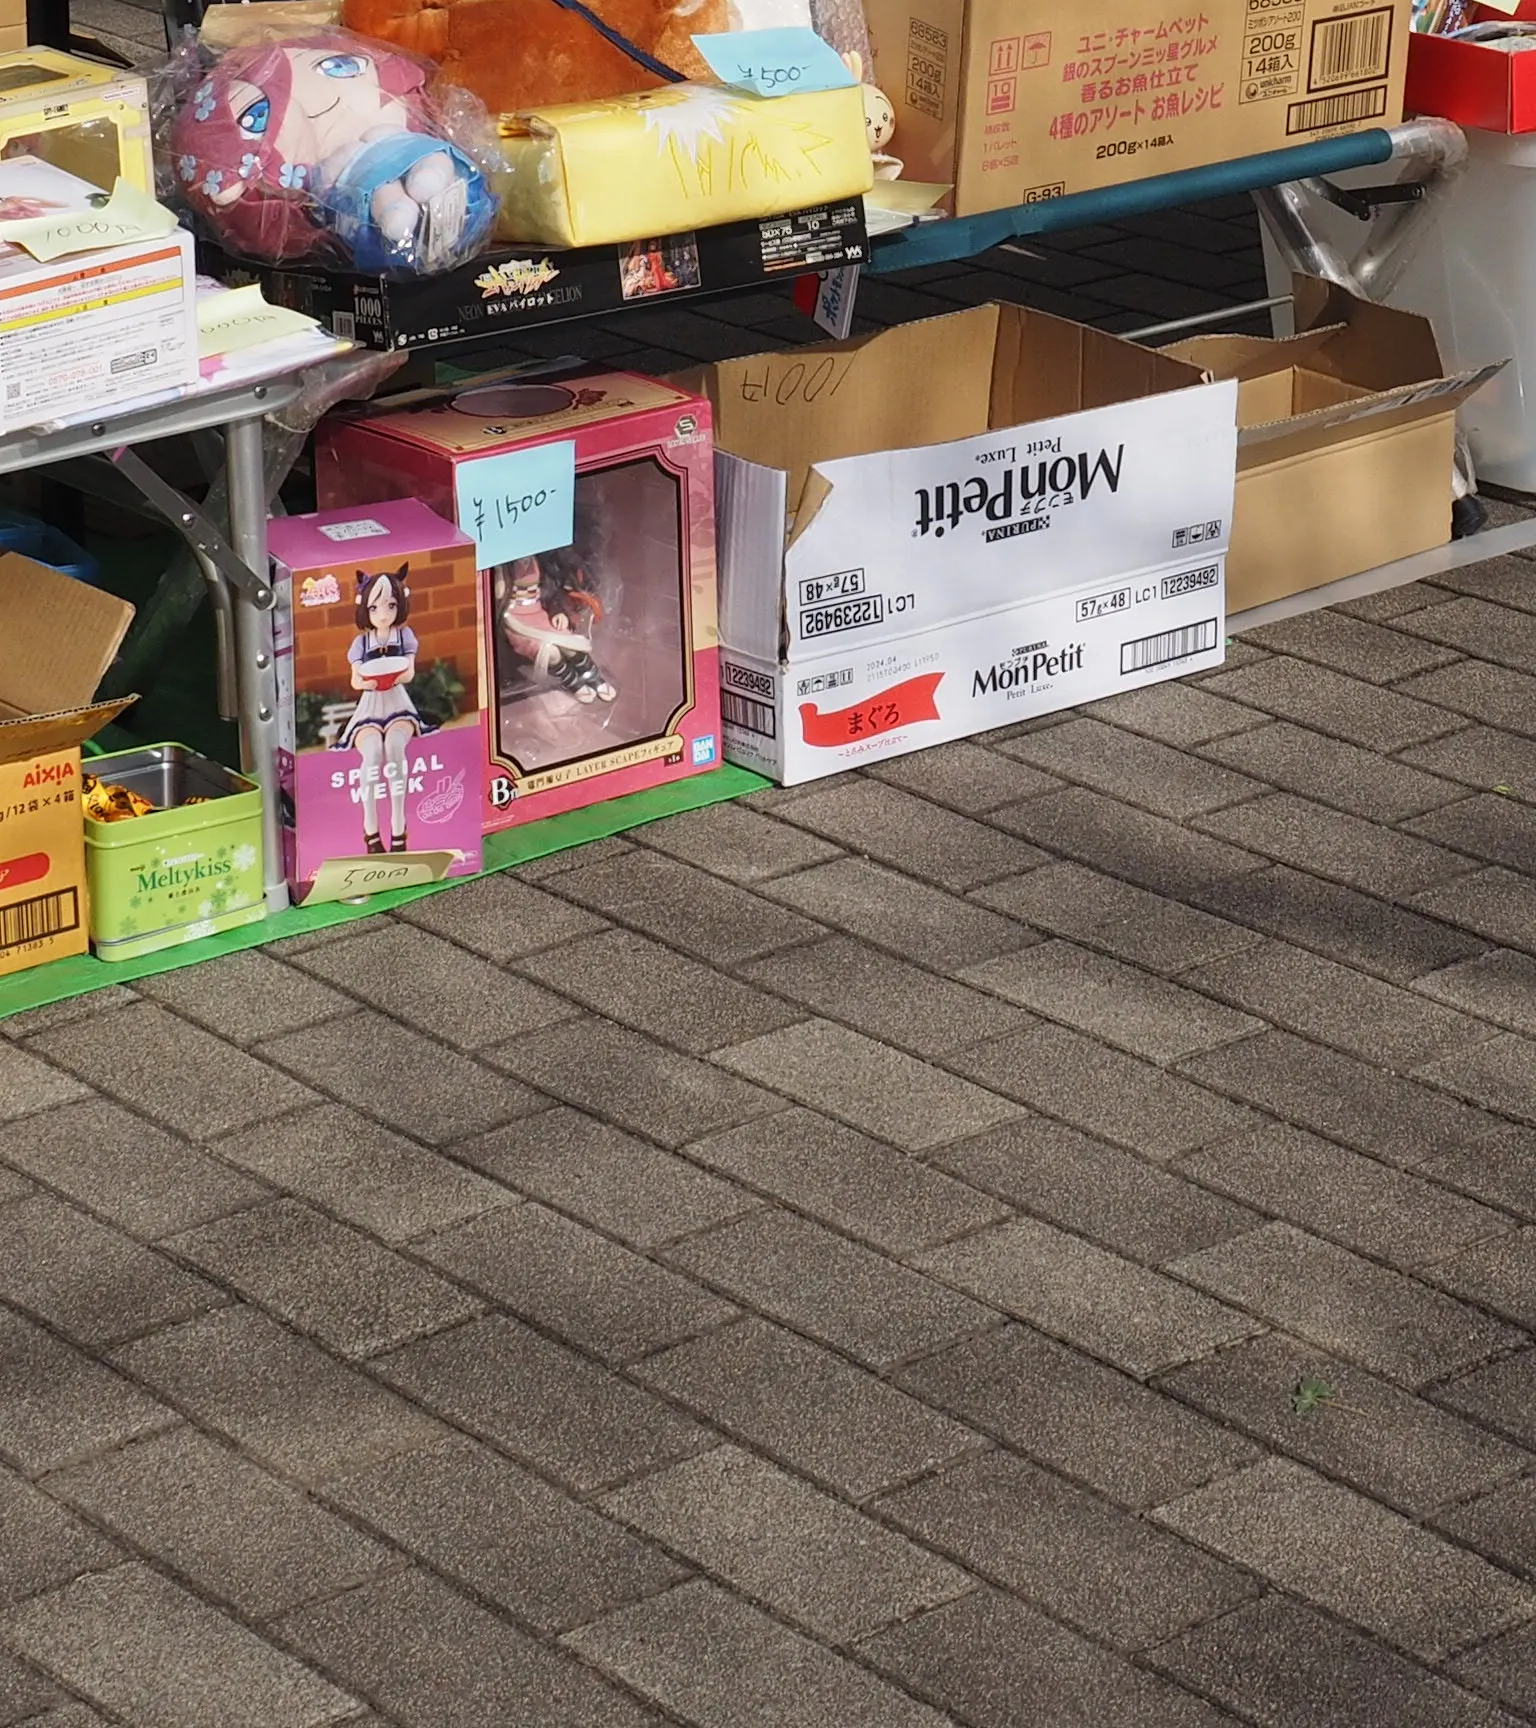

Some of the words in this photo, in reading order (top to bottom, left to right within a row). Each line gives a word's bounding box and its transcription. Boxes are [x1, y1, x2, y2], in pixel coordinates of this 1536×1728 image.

[910, 21, 947, 49] 68583
[1249, 33, 1297, 55] 200g
[912, 57, 942, 83] 200g
[1247, 54, 1294, 77] 14箱入
[910, 74, 941, 99] 14箱入
[993, 81, 1011, 95] 10
[1080, 63, 1199, 103] 香るお魚仕立て
[1260, 75, 1292, 89] unicharm
[1048, 99, 1146, 141] 4種のアソート
[1151, 81, 1226, 122] お魚レシピ
[354, 297, 382, 318] 1000
[486, 302, 507, 315] EVA
[509, 293, 555, 311] パイロット
[1026, 436, 1062, 455] Petit
[1019, 490, 1075, 517] モンプチ
[986, 520, 1040, 544] PURINA
[1135, 585, 1158, 605] LC1
[1163, 569, 1217, 598] 12239492
[887, 593, 916, 614] LC1
[805, 599, 881, 634] 12239492
[726, 666, 772, 696] 12239492
[1005, 688, 1027, 702] Petit
[846, 703, 902, 736] まぐろ
[330, 753, 445, 789] SPECIAL
[576, 760, 607, 777] LAYER
[350, 774, 425, 804] WEEK
[136, 857, 232, 894] Meltykiss
[343, 867, 409, 891] 500円
